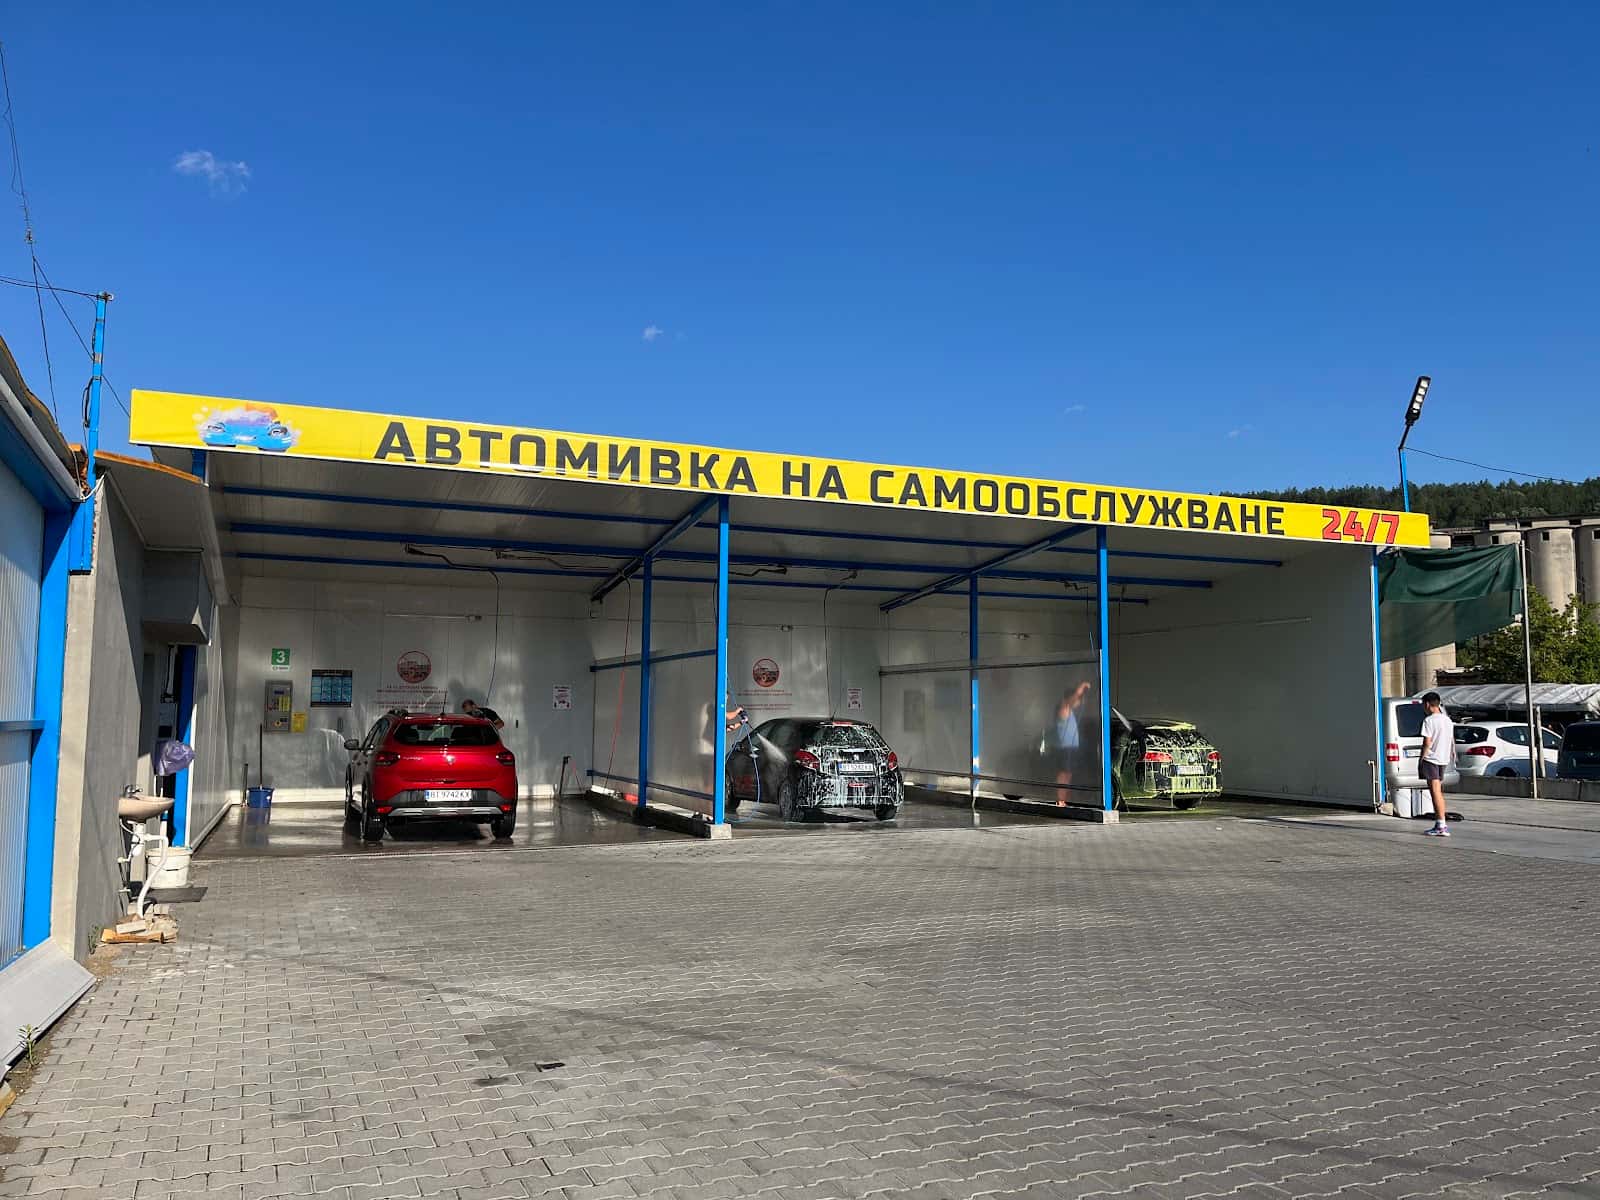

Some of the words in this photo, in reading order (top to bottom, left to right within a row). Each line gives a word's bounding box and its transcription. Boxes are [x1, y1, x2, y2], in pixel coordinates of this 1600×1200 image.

[372, 421, 757, 493] АВТОМИВКА
[782, 461, 848, 500] НА
[870, 469, 1285, 537] САМООБСЛУЖВАНЕ
[1322, 508, 1399, 546] 24/7
[275, 650, 286, 664] 3
